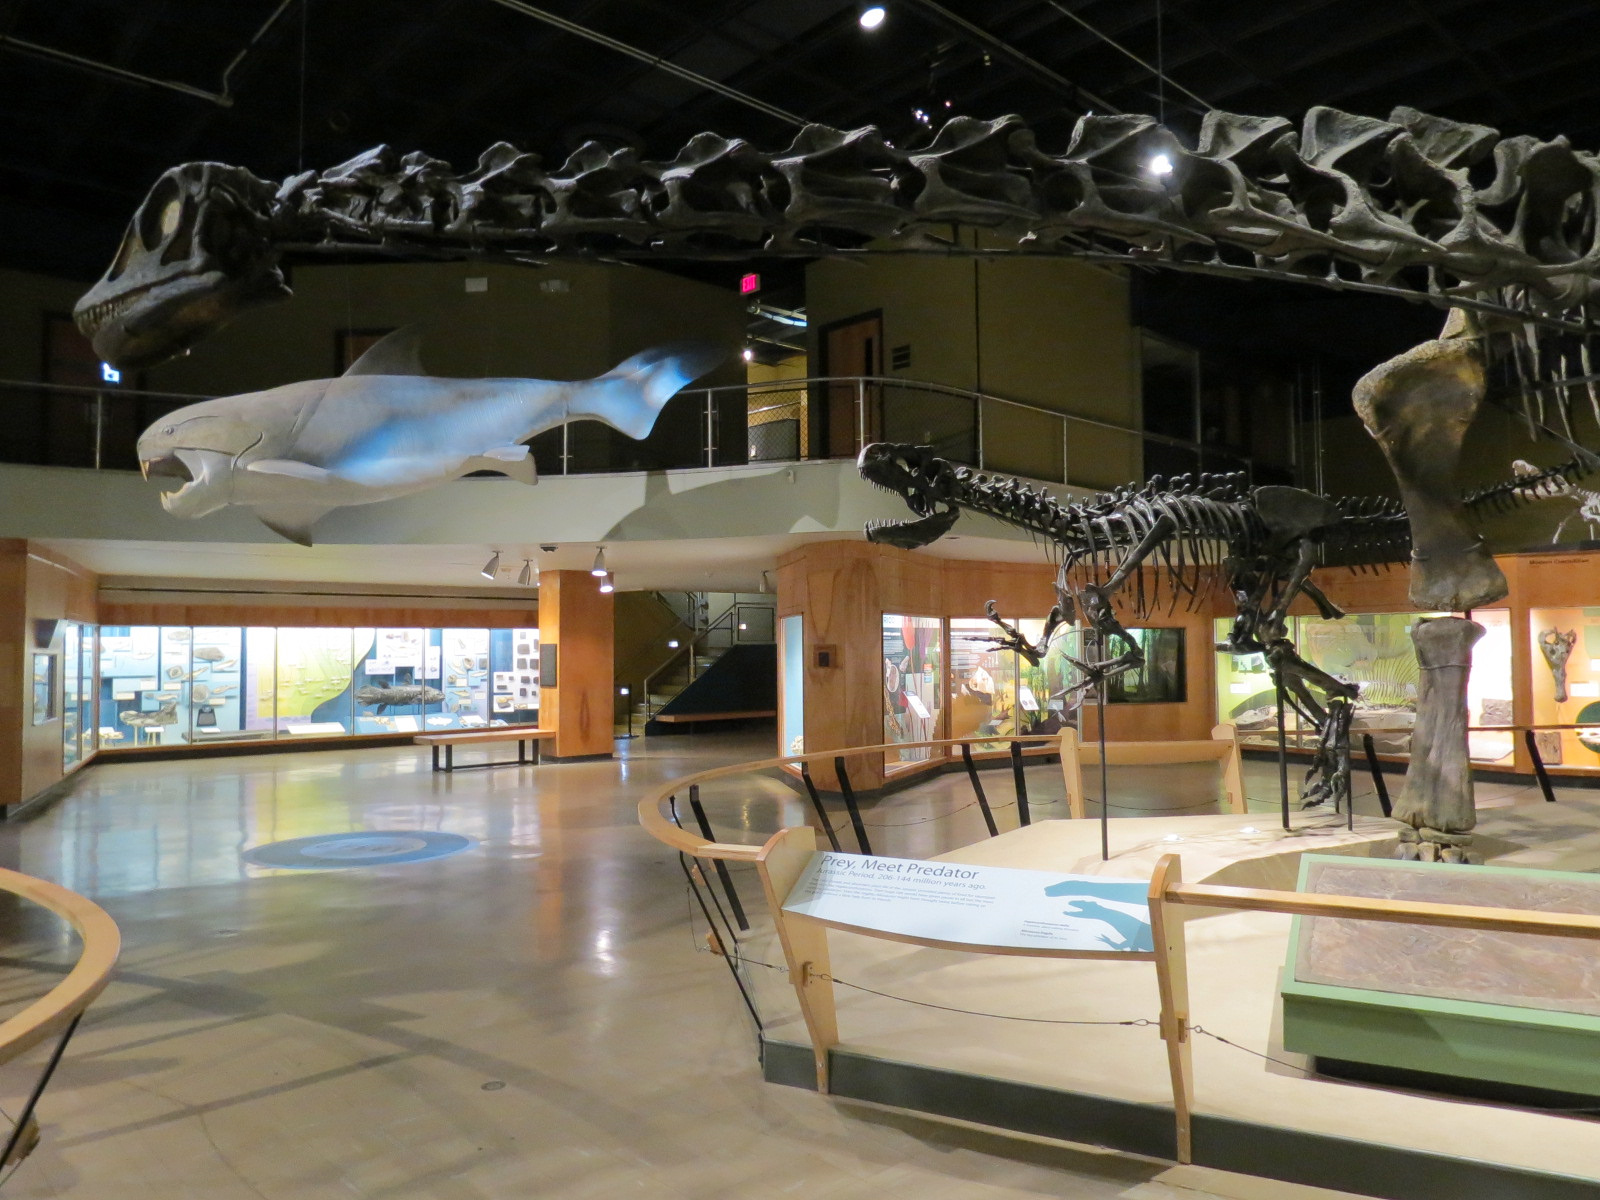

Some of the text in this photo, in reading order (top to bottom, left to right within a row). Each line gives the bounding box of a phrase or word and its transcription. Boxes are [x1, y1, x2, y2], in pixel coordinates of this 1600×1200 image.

[742, 274, 756, 292] EXIT
[817, 867, 846, 876] Jurassic
[877, 873, 912, 882] 206-144
[912, 877, 942, 885] million
[943, 880, 966, 888] years
[821, 855, 980, 880] Prey, Meet Predator
